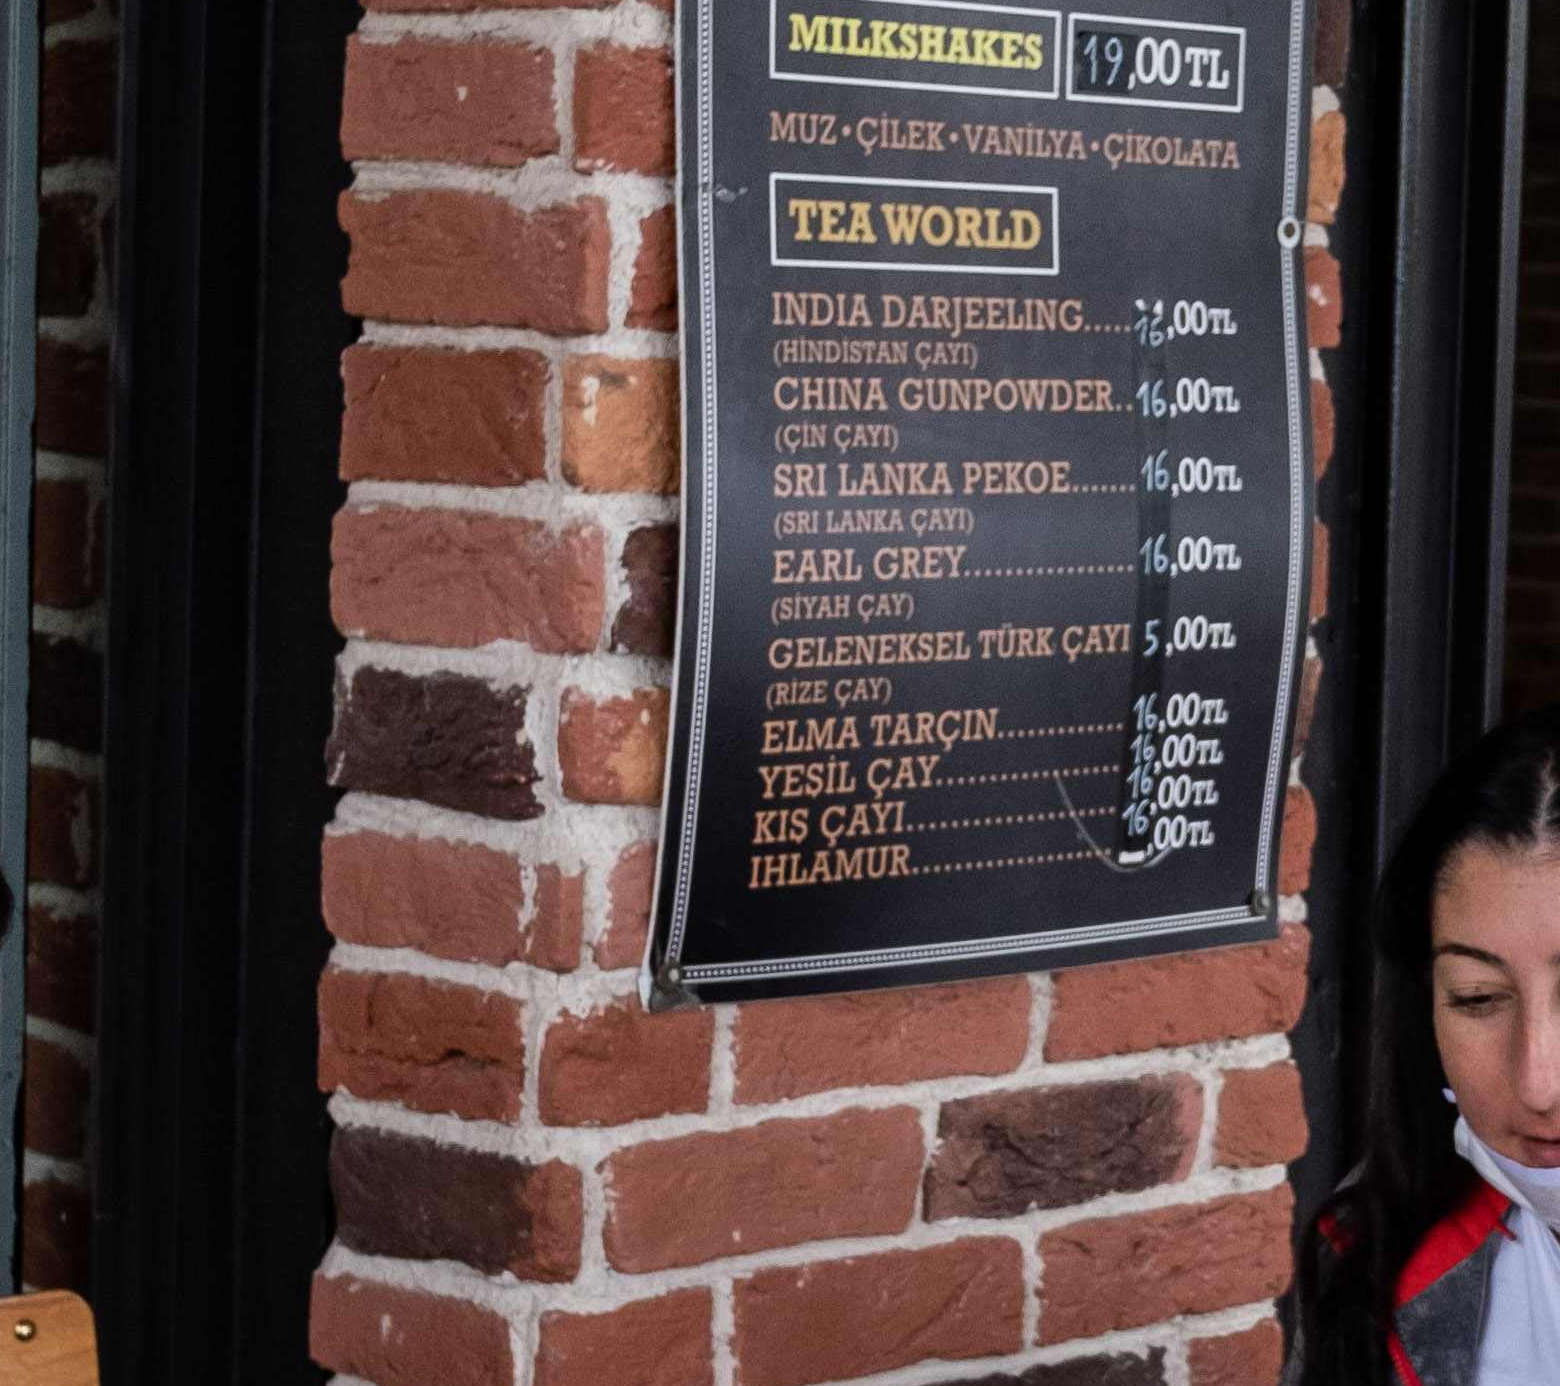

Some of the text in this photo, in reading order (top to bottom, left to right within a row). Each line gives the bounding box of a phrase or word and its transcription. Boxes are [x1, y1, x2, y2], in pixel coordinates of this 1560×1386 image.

[788, 12, 1045, 72] MILKSHAKES
[788, 197, 1042, 251] TEA WORLD
[771, 291, 873, 328] INDIA
[881, 293, 1084, 338] DARJEELING
[915, 340, 980, 371] ÇAYI)
[773, 376, 889, 412] CHINA
[897, 377, 1114, 413] GUNPOWDER
[833, 423, 900, 455] ÇAYI)
[773, 462, 827, 498] SRI
[837, 462, 954, 497] LANKA
[961, 461, 1071, 495] PEKOE
[773, 506, 976, 541] (SRI LANKA ÇAYI)
[772, 547, 863, 584] EARL
[872, 545, 968, 580] GREY
[857, 592, 915, 623] ÇAY)
[768, 628, 971, 671] GELENEKSEL
[978, 623, 1055, 659] TÜRK
[1061, 623, 1132, 660] ÇAYI
[833, 676, 893, 708] ÇAY)
[761, 715, 861, 755] ELMA
[870, 708, 999, 748] TARÇIN
[758, 754, 856, 799] YEŞİL
[866, 753, 942, 793] ÇAY
[752, 808, 811, 846] KIŞ
[820, 801, 906, 844] ÇAYI
[747, 845, 912, 889] IHLAMUR
